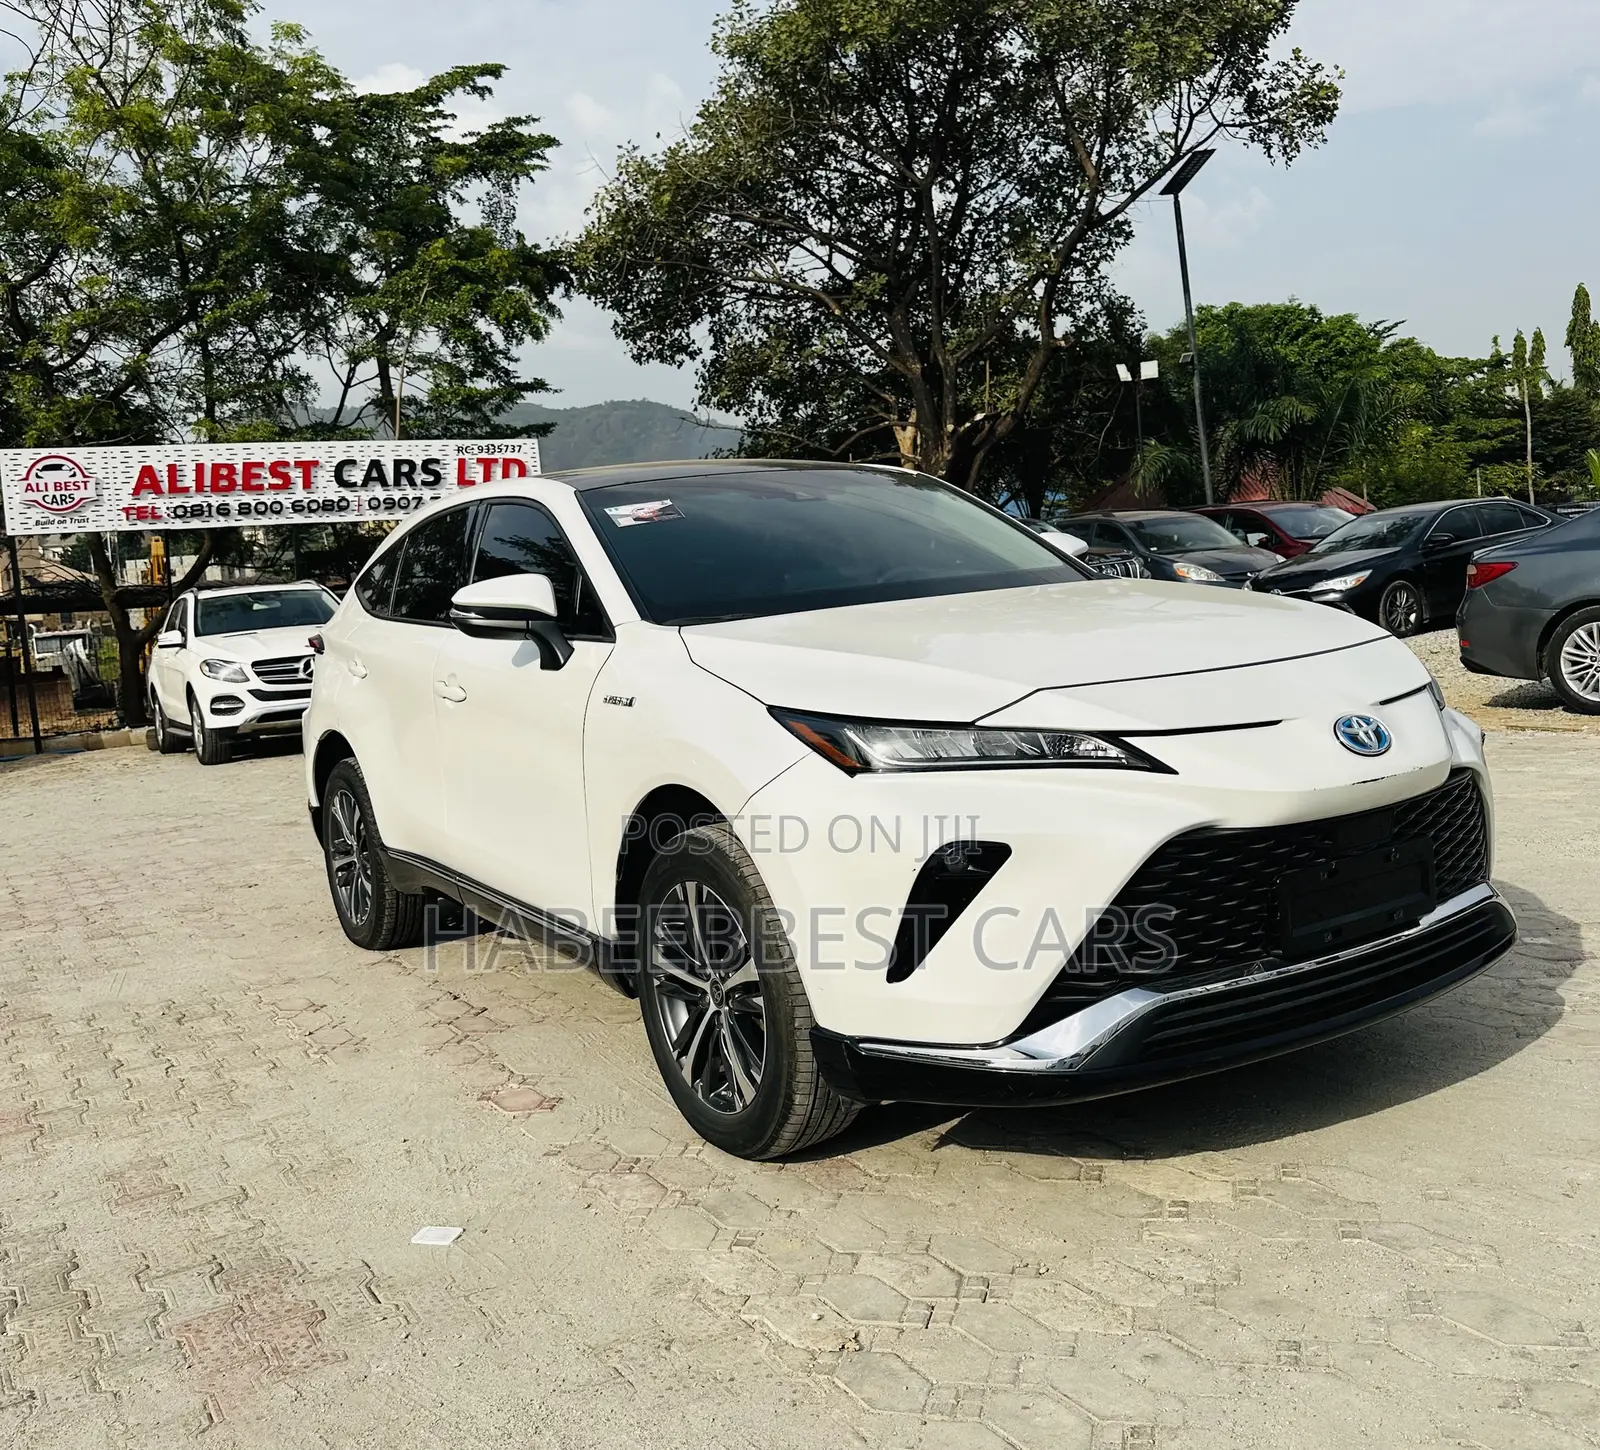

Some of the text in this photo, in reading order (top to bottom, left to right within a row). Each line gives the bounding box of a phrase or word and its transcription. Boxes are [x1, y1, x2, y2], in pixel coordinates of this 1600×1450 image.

[477, 443, 522, 454] 9335737
[131, 457, 527, 497] ALIBEST CARS LTD
[24, 480, 90, 493] ALI BEST
[42, 493, 76, 506] CARS
[173, 502, 231, 519] 0816
[237, 500, 284, 516] 800
[291, 497, 351, 514] 6080
[367, 496, 423, 511] 0907
